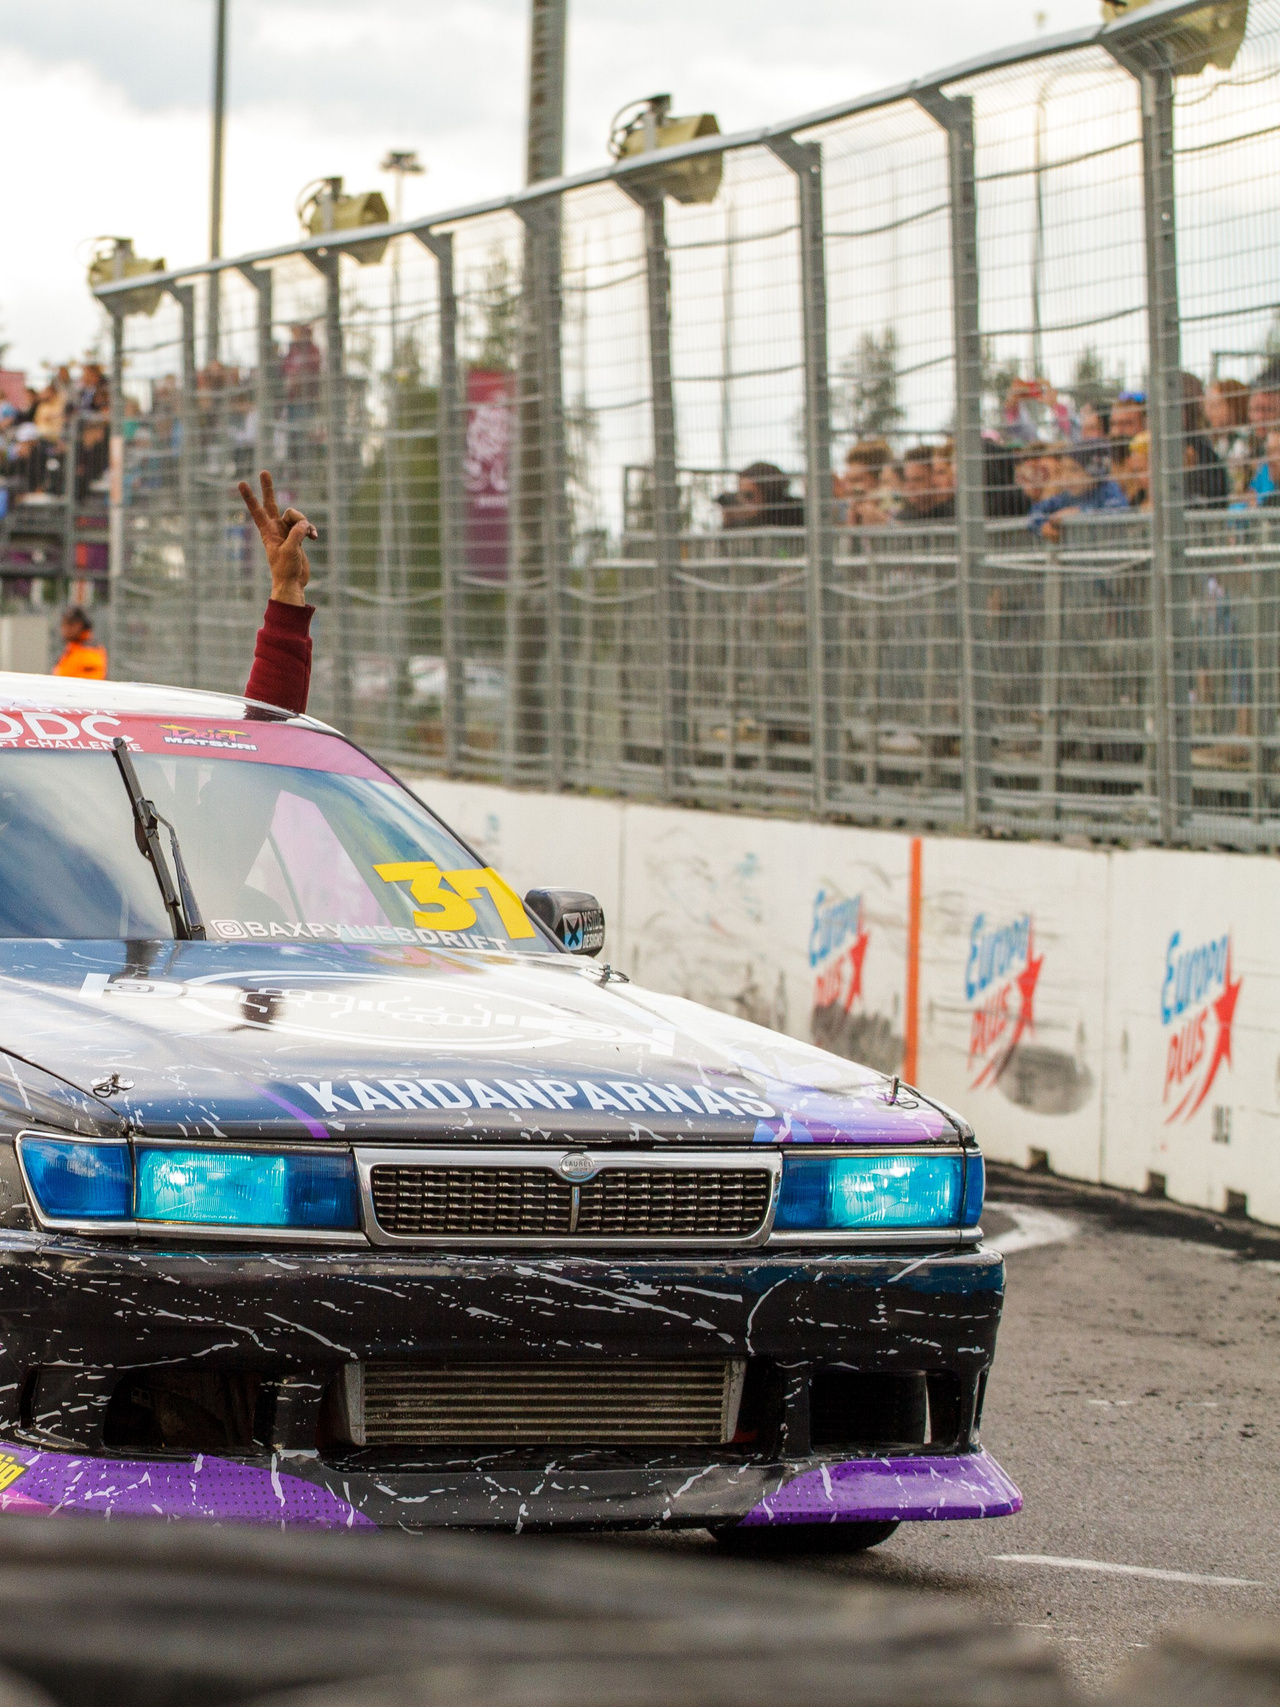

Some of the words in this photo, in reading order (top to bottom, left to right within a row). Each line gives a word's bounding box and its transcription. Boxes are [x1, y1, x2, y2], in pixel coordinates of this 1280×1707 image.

[25, 738, 144, 752] CHALLENE
[163, 736, 258, 751] MATSURI
[372, 861, 536, 940] 37
[297, 1078, 776, 1118] KARDANPARNAS
